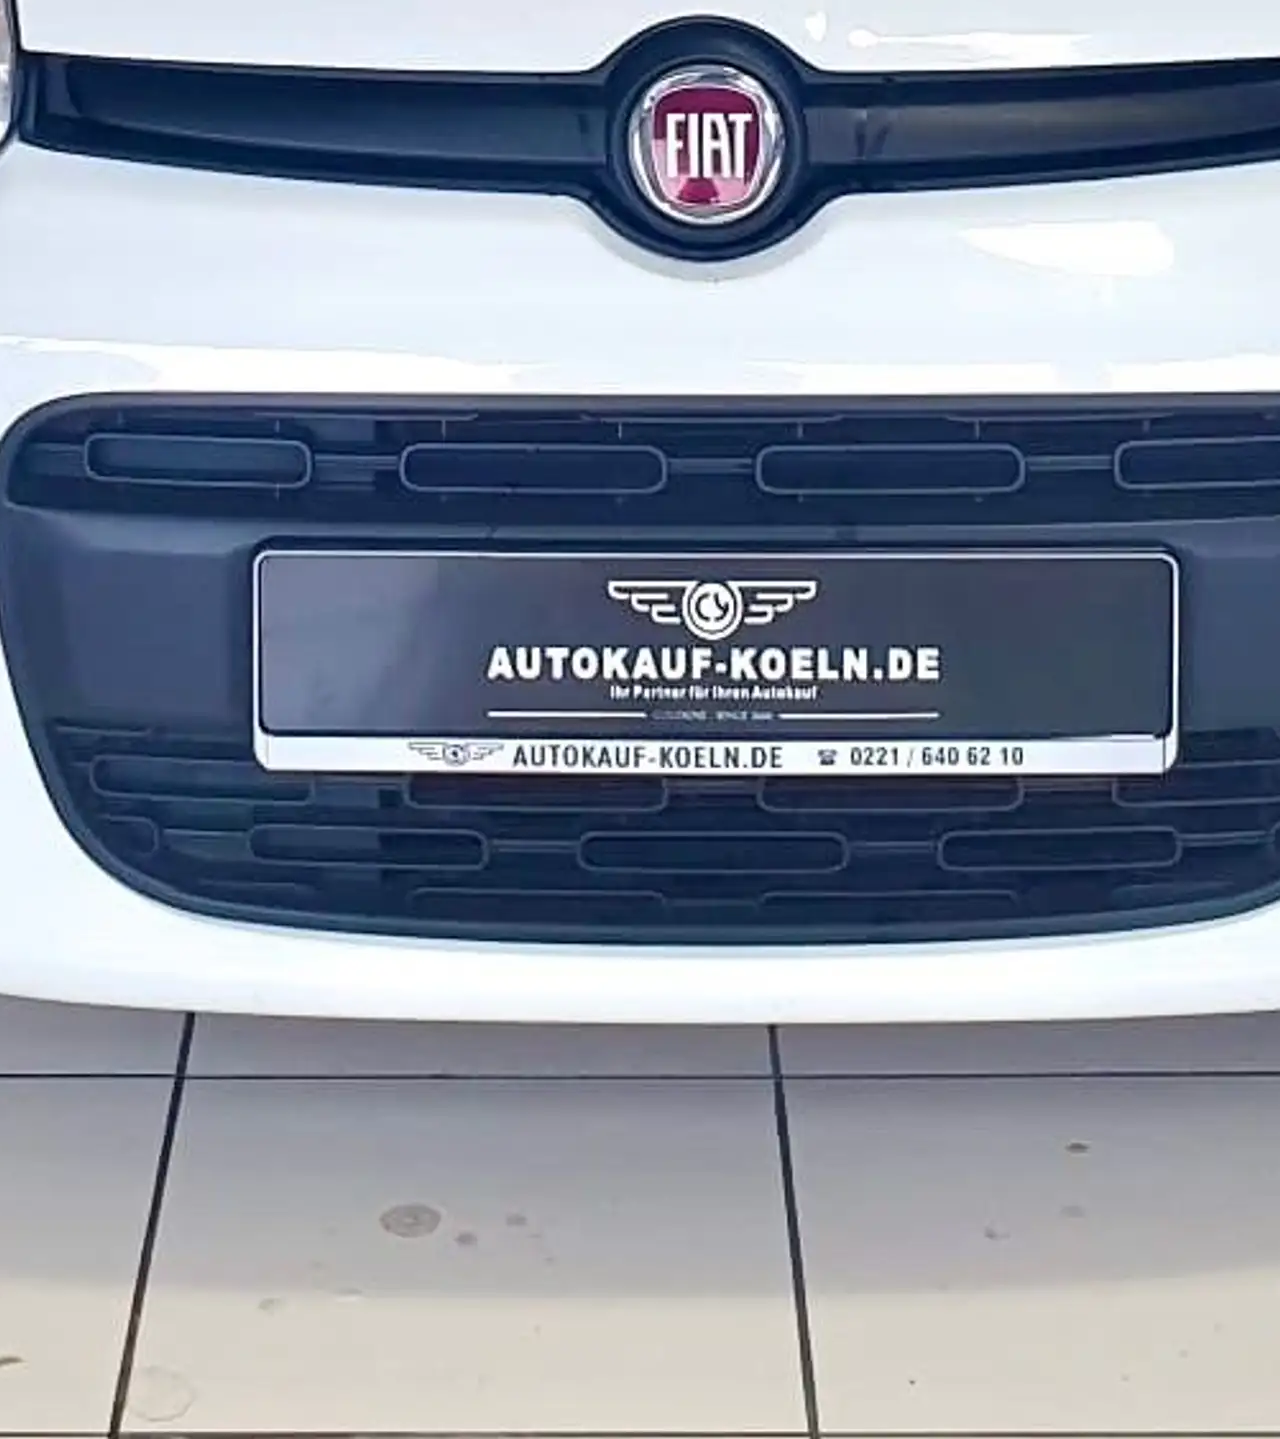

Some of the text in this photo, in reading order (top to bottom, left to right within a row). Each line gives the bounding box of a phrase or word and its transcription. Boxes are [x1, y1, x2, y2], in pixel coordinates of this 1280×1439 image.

[666, 112, 752, 178] FIAT
[487, 646, 940, 680] AUTOKAUF-KOELN.DE
[512, 746, 783, 768] AUTOKAUF-KOELN.DE
[850, 746, 898, 766] 0221
[922, 746, 959, 766] 640
[966, 746, 991, 766] 62
[1000, 746, 1024, 766] 10
